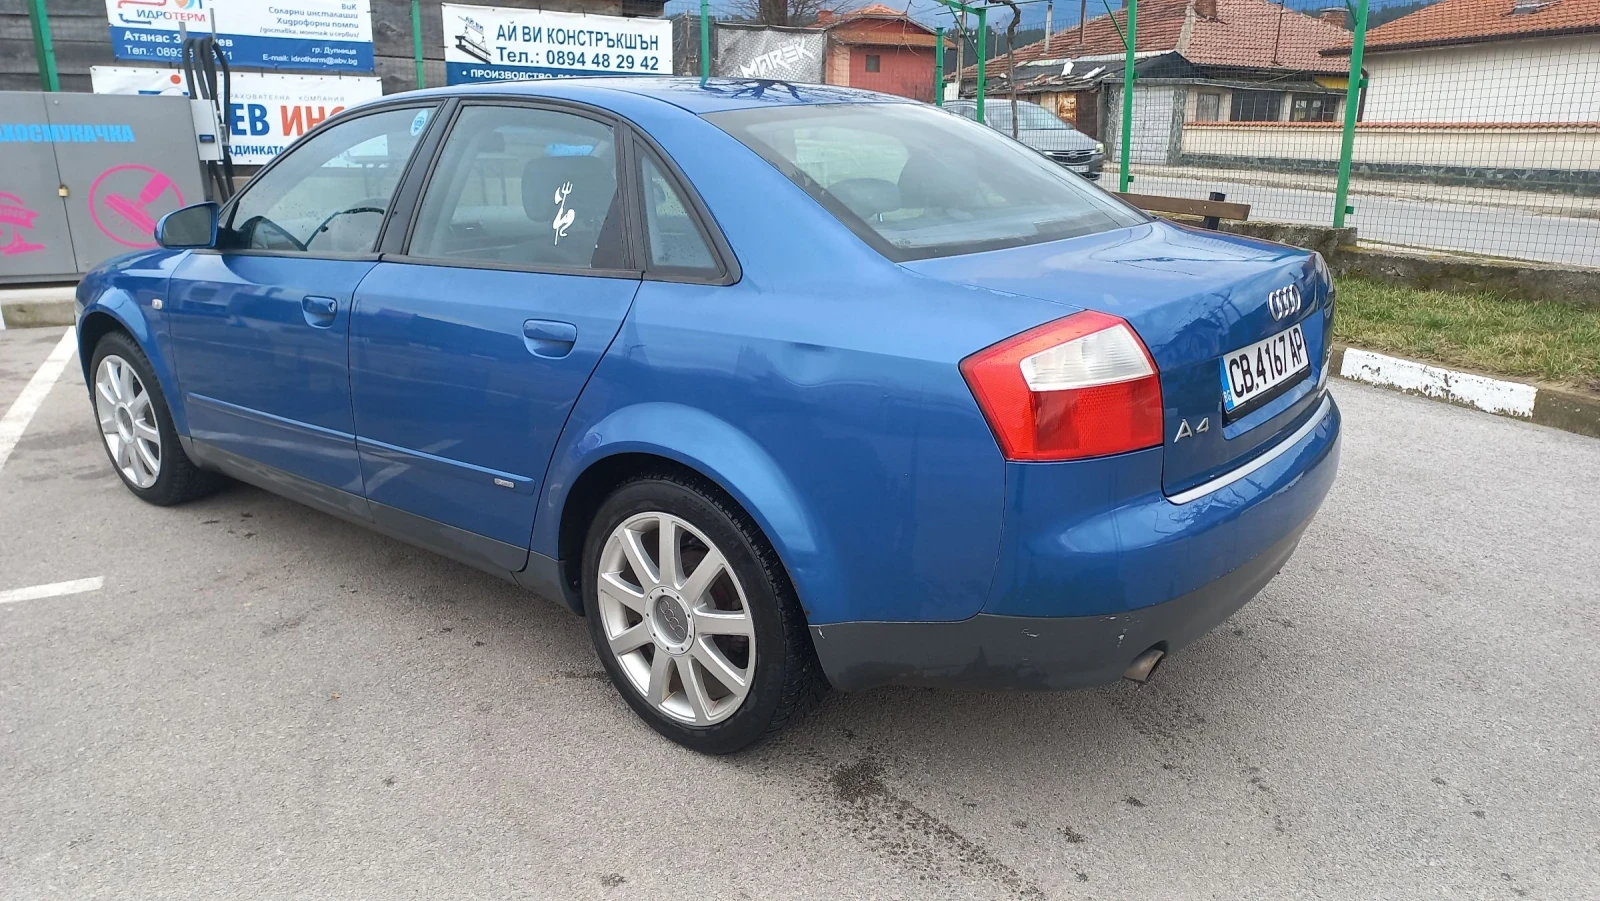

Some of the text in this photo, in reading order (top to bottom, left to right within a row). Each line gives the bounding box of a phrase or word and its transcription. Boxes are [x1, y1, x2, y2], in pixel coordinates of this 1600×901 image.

[136, 9, 206, 22] ИДРОТЕРМ
[268, 6, 358, 19] Соларни инсталации
[276, 17, 359, 29] Хидрофорни помпи
[124, 30, 171, 43] Атанас
[496, 20, 659, 51] АЙ ВИ КОНСТРЪКШЪН
[124, 45, 154, 56] Тел.:
[323, 46, 357, 55] Дупница
[262, 53, 289, 62] E-mail:
[496, 46, 659, 71] Тел.: 0894 48 29 42
[470, 68, 552, 80] ПРОИЗВОДСТВО
[218, 92, 346, 103] СРАХОВАТЕЛНА КОМПАНИЯ
[229, 103, 271, 136] ЕВ
[0, 123, 136, 143] ХОСМУКАЧКА
[1255, 335, 1287, 385] 4167
[1173, 416, 1209, 443] A4
